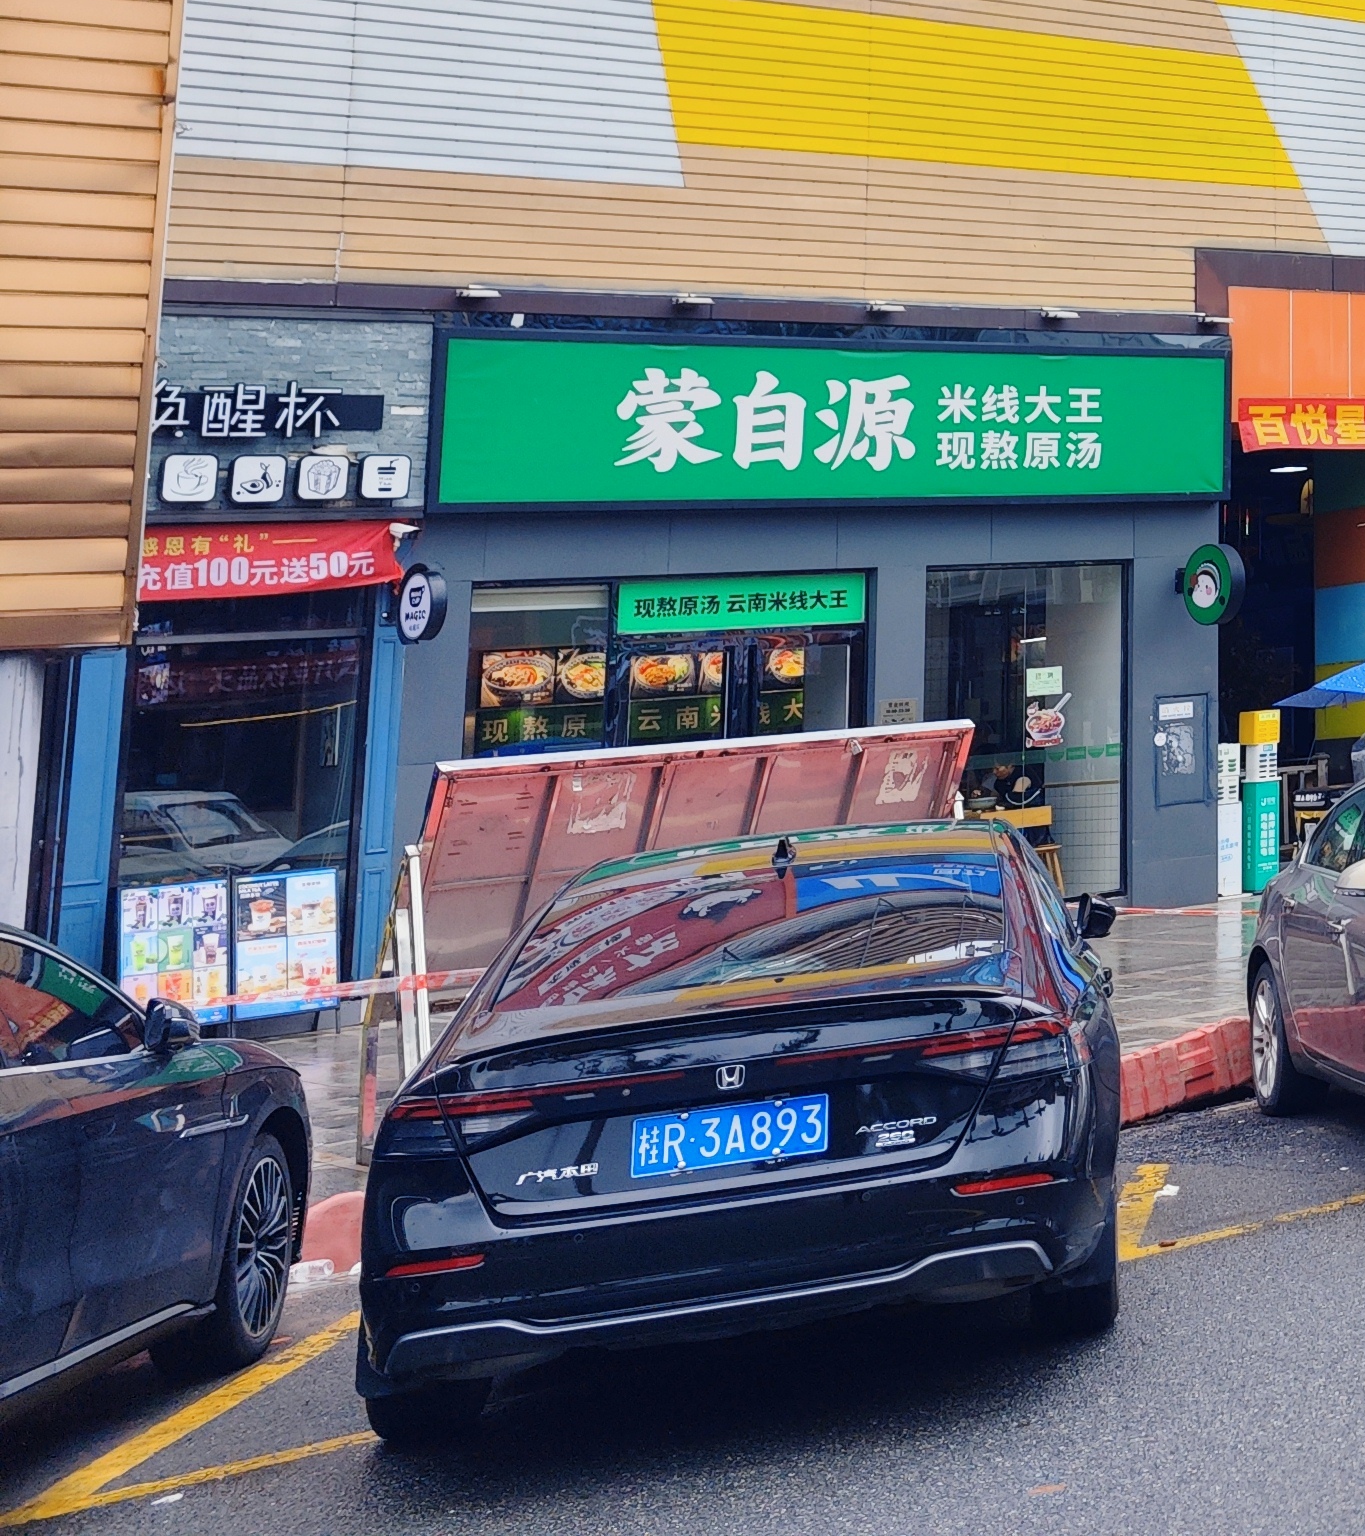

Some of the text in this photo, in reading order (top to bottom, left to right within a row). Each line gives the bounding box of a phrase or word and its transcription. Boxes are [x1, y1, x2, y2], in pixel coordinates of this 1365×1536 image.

[613, 366, 917, 473] 蒙自源
[936, 383, 1104, 425] 米线大王
[936, 428, 1104, 471] 现熬原汤
[139, 550, 375, 592] 充值100元送50元
[633, 589, 849, 619] 现熬原汤 云南米线大王
[482, 712, 587, 745] 现熬原
[637, 1103, 824, 1167] 桂R·3A893
[854, 1116, 938, 1136] ACCORD
[515, 1162, 600, 1187] 广汽本田
